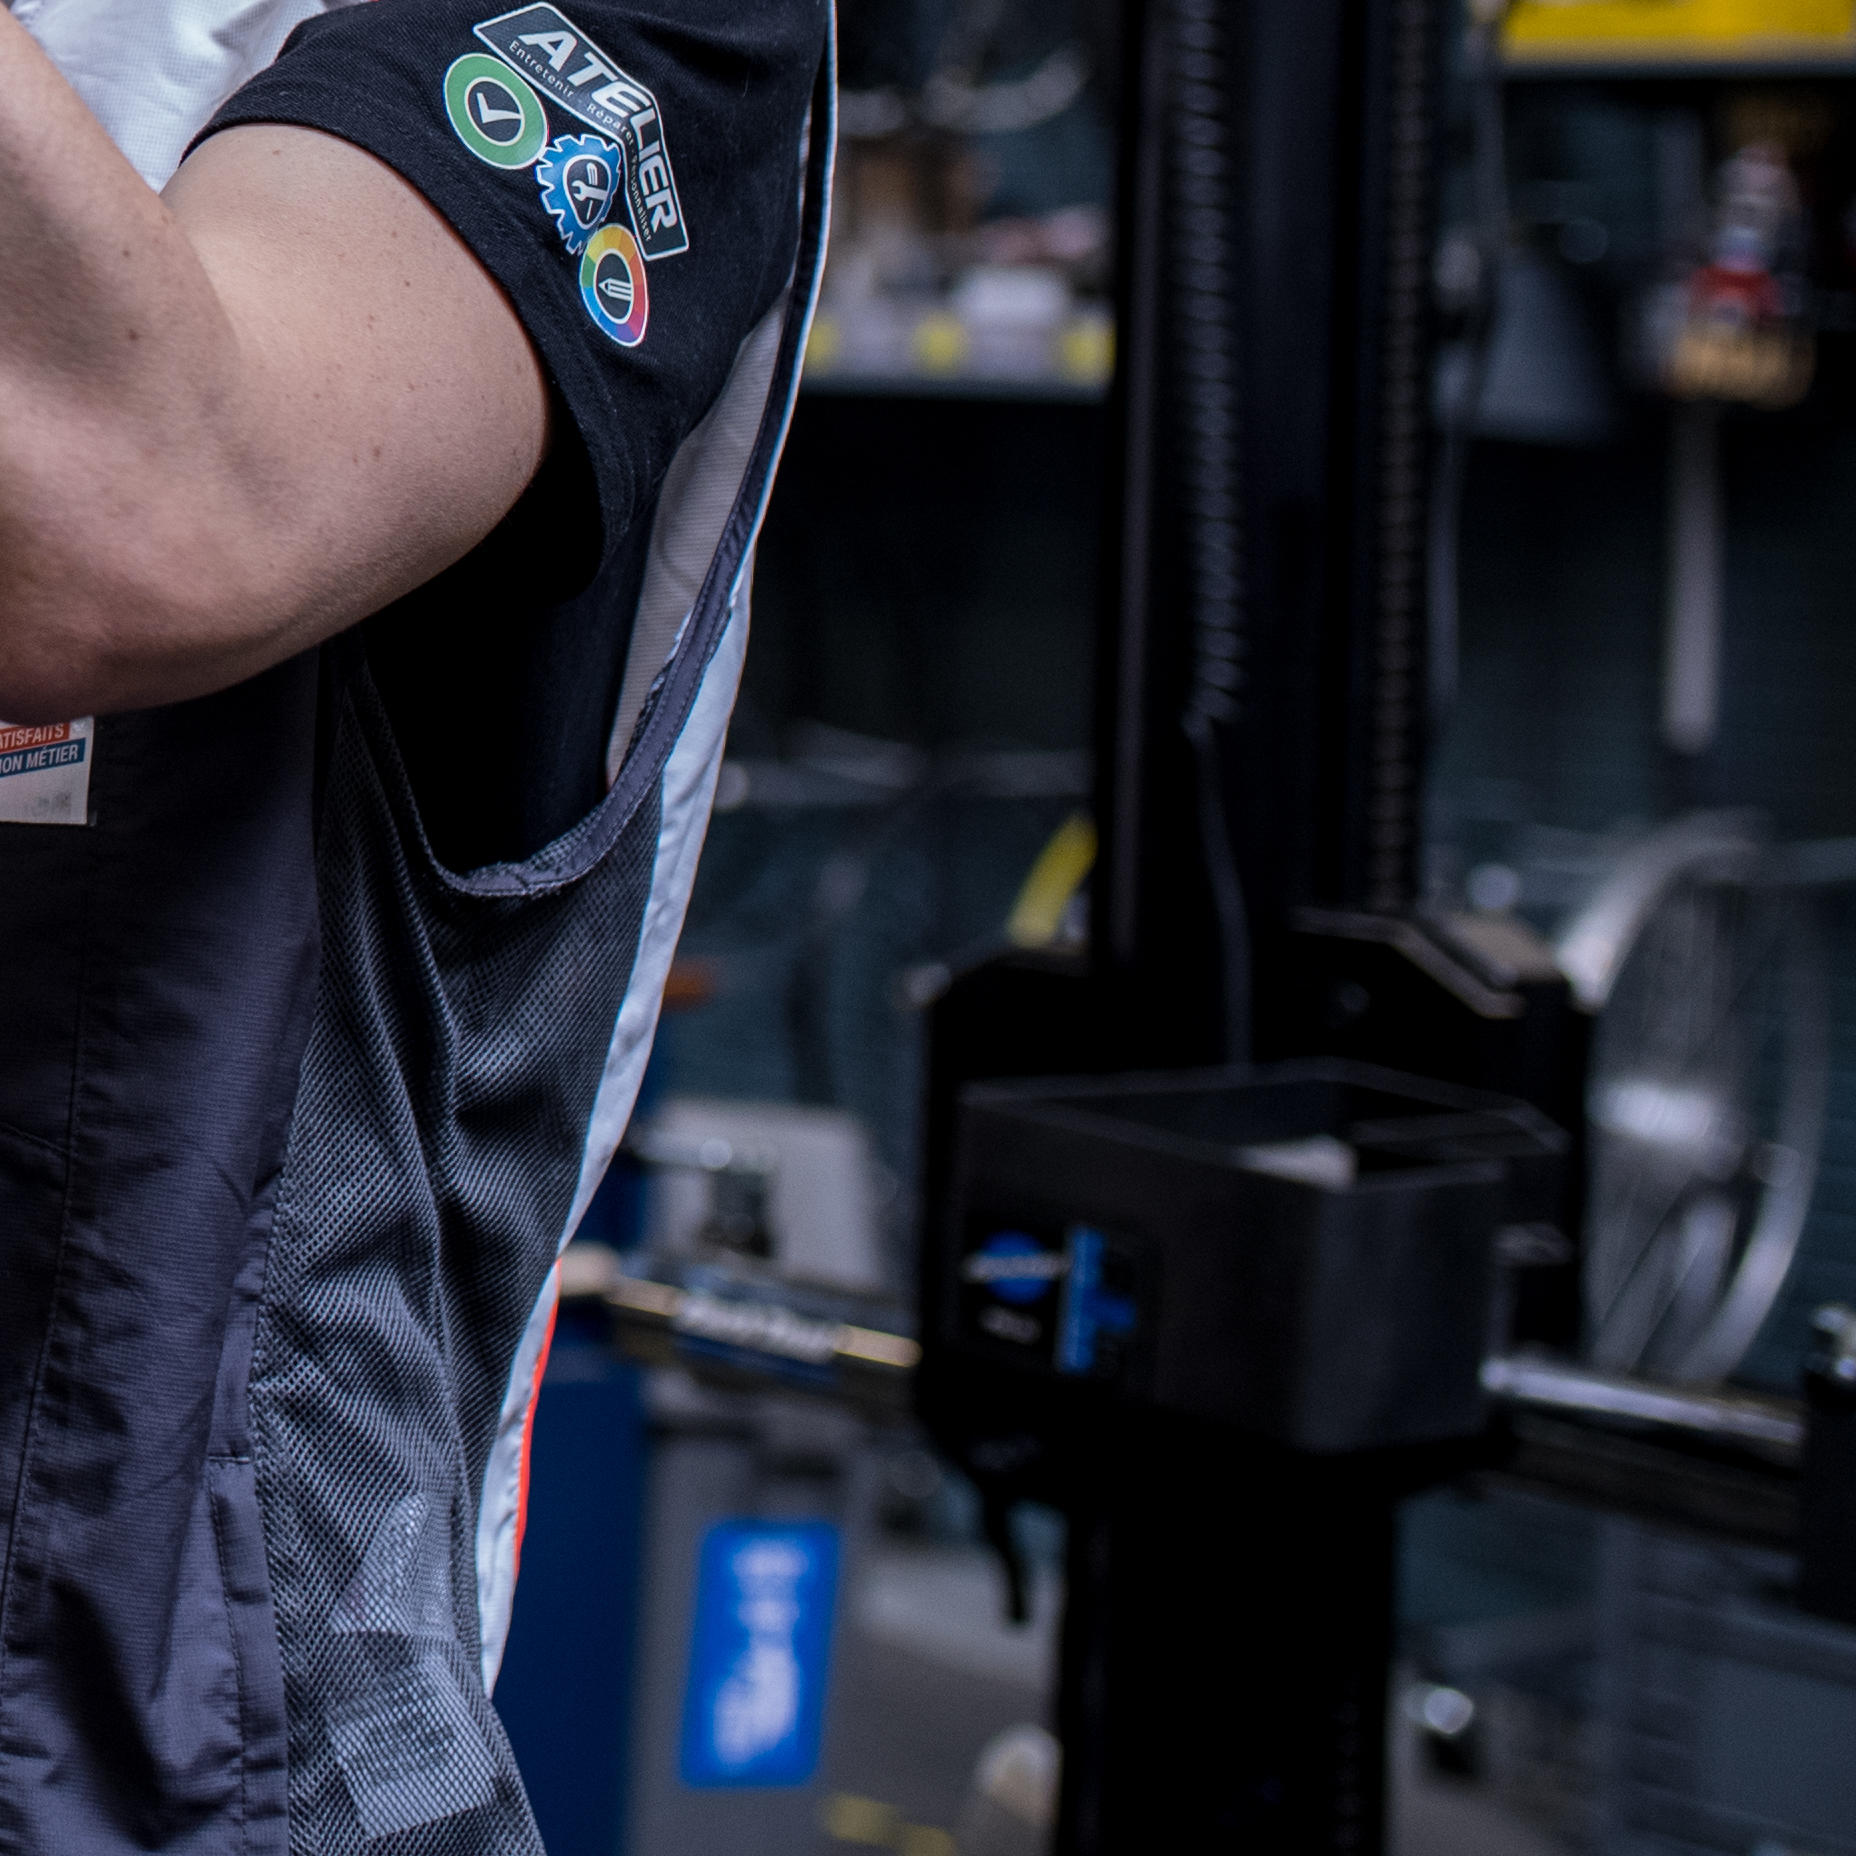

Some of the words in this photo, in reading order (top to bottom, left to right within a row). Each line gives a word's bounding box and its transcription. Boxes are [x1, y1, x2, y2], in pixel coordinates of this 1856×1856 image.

[509, 39, 575, 99] Entretenir
[587, 103, 636, 147] Réparer
[518, 29, 678, 230] ATELIER
[26, 745, 79, 772] MÉTIER
